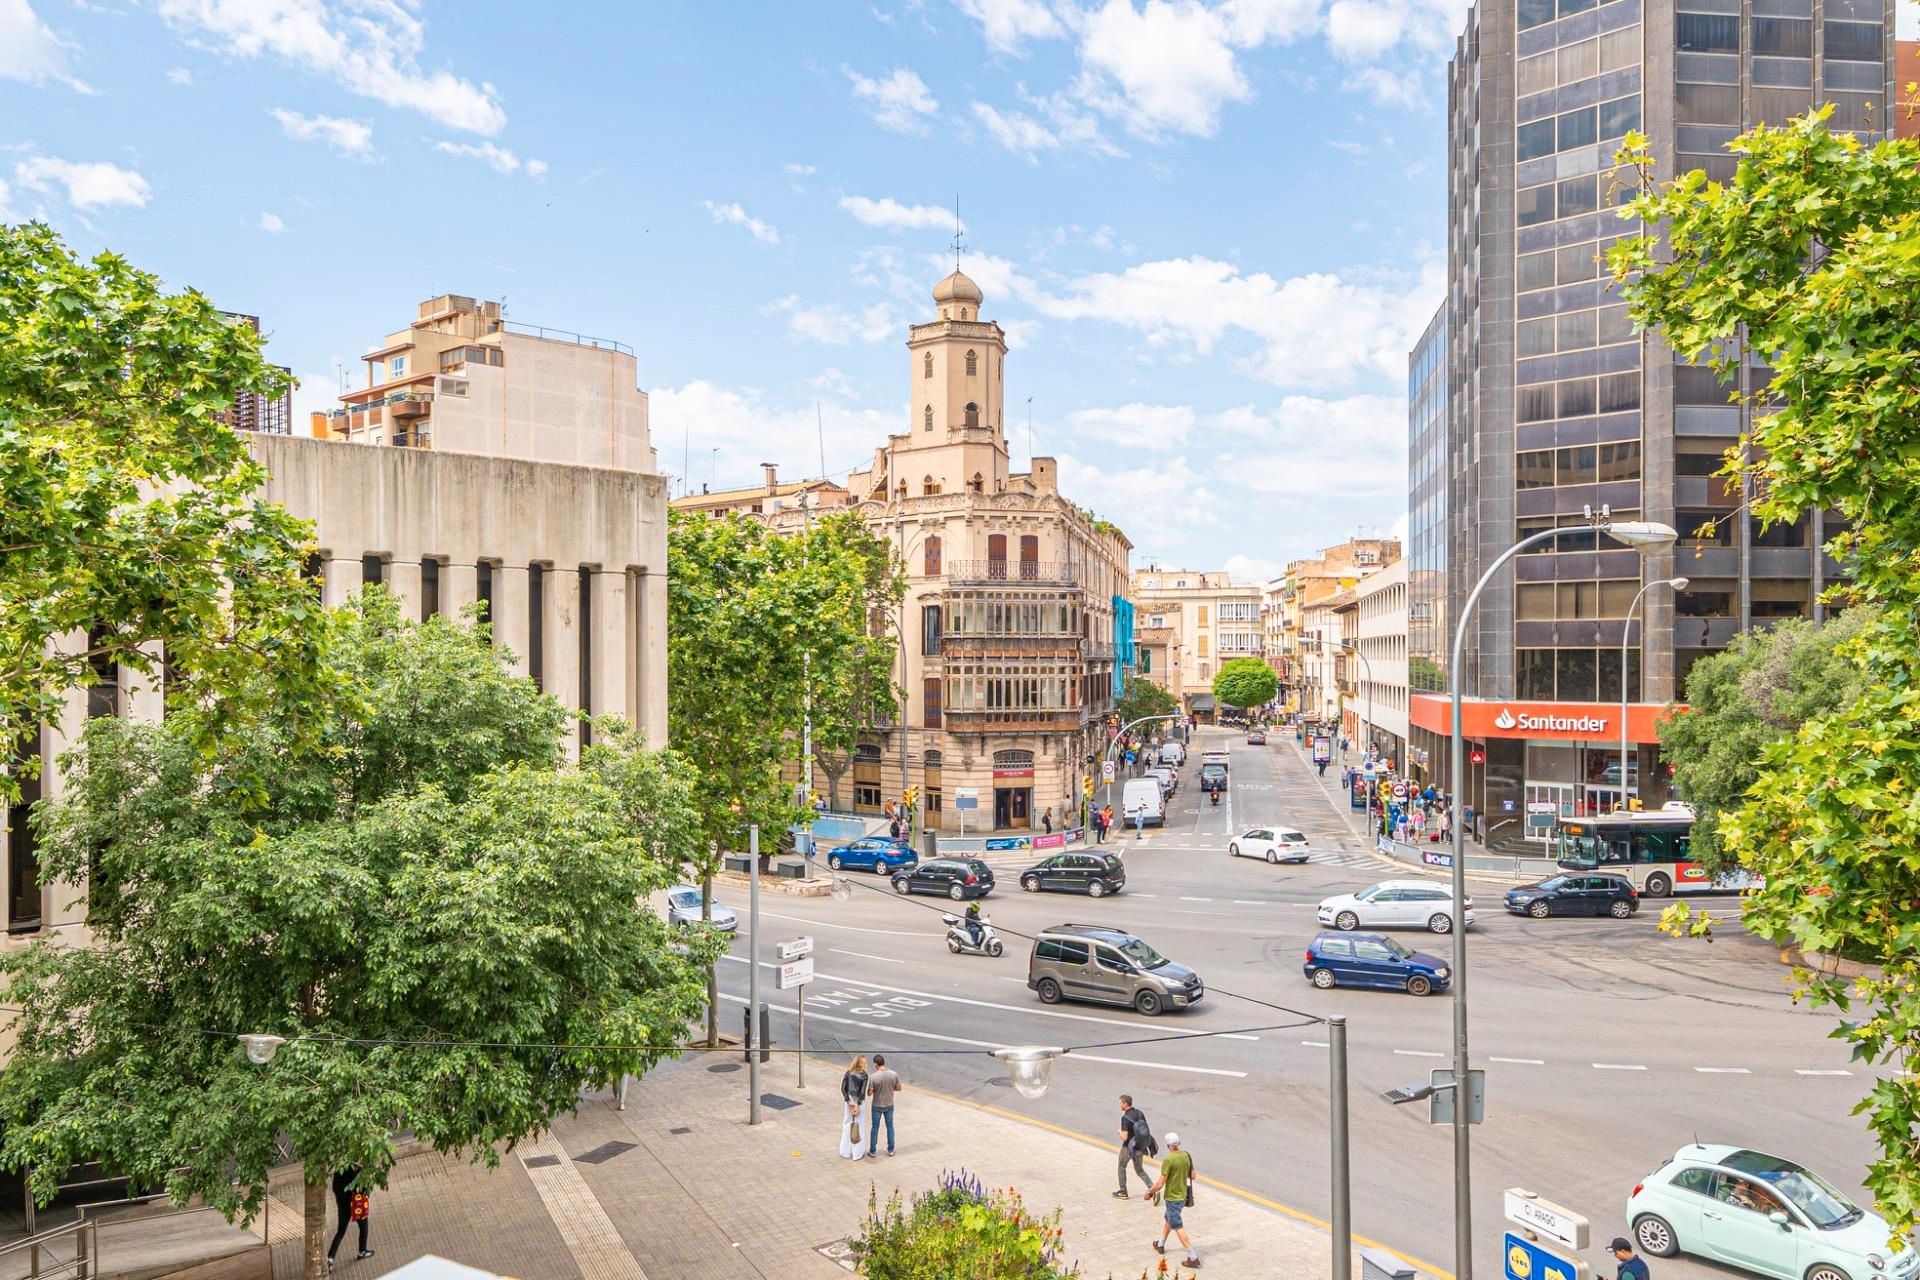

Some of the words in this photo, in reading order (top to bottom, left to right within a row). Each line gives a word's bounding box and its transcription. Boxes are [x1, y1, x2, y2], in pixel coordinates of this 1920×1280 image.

[1518, 713, 1607, 732] Santander
[1686, 868, 1703, 876] IKEA
[797, 987, 882, 1008] TAXI
[849, 996, 934, 1017] BUS
[1511, 1254, 1529, 1269] LIDL
